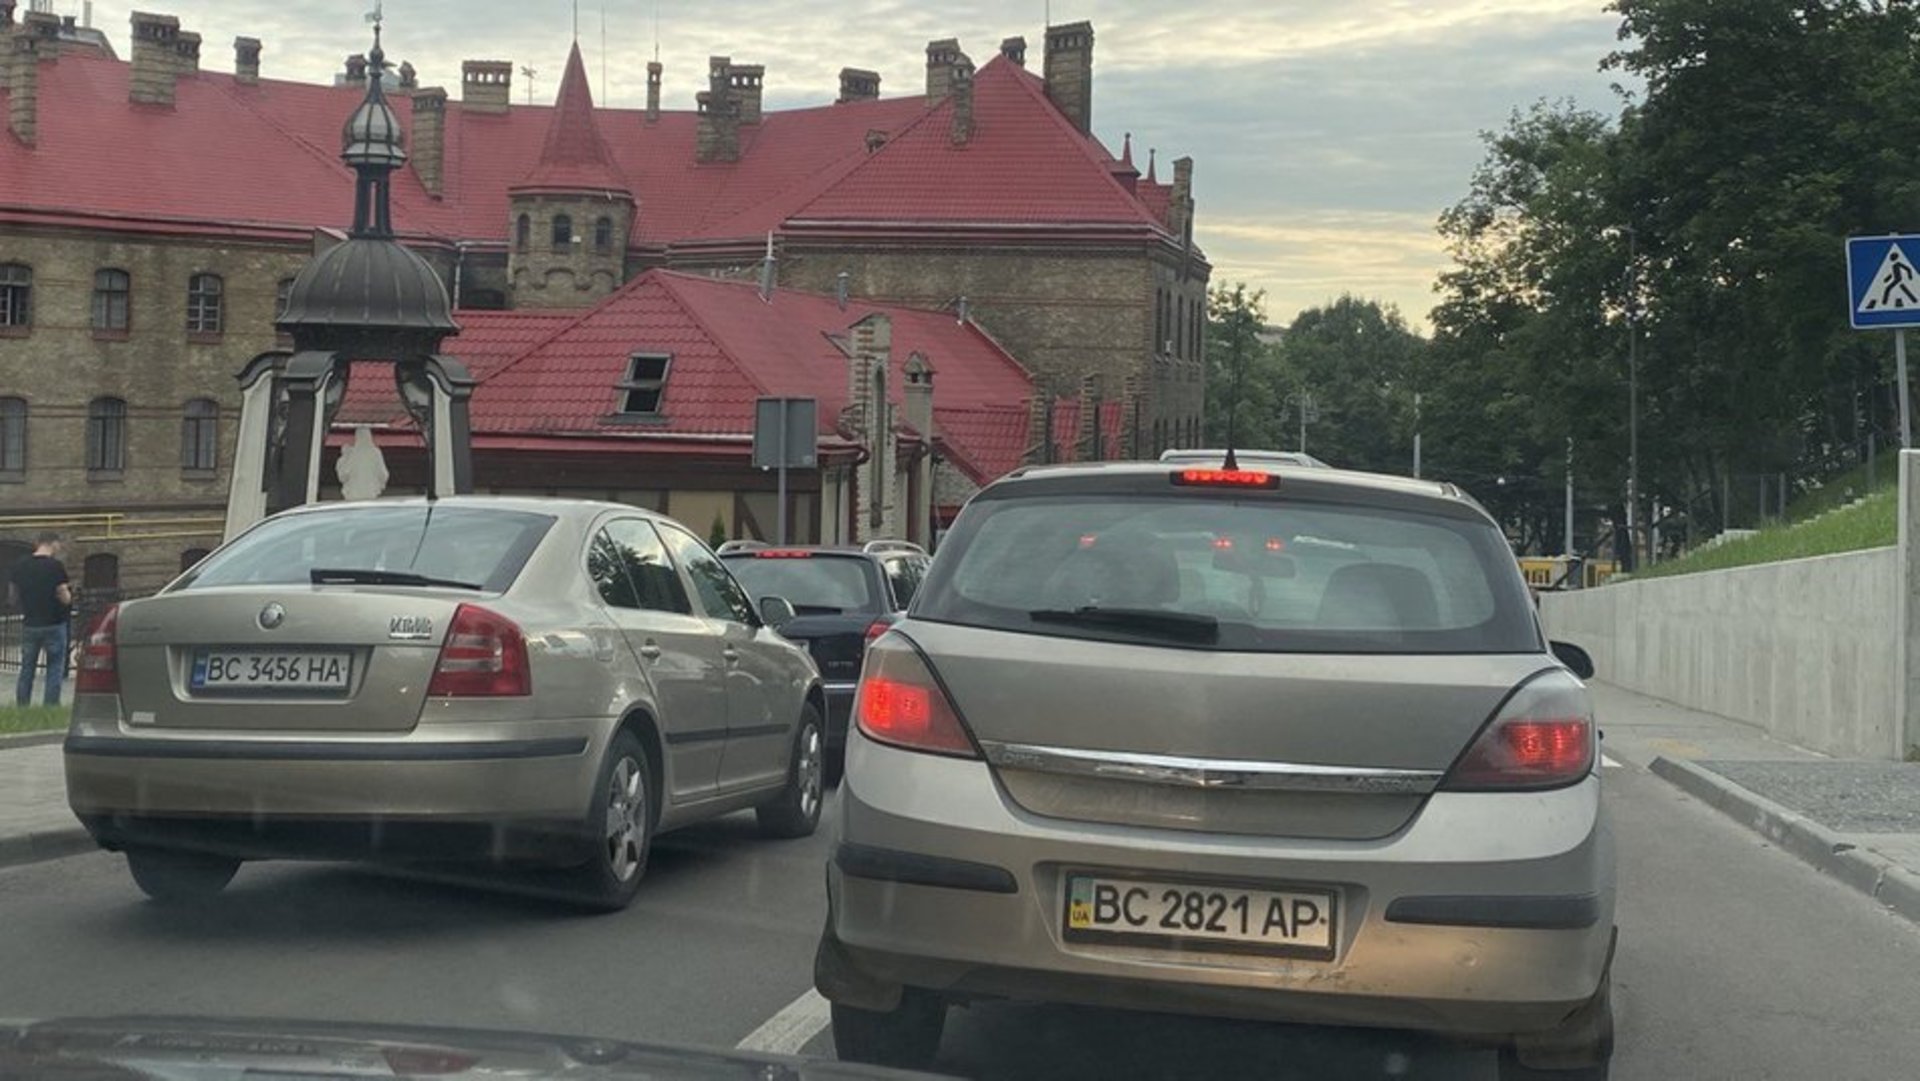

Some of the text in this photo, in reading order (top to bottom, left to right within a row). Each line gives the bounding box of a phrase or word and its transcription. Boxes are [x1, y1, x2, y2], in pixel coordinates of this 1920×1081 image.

[207, 656, 341, 683] BC 3456 HA
[1072, 907, 1090, 924] UA
[1093, 884, 1320, 938] BC 2821 AP
